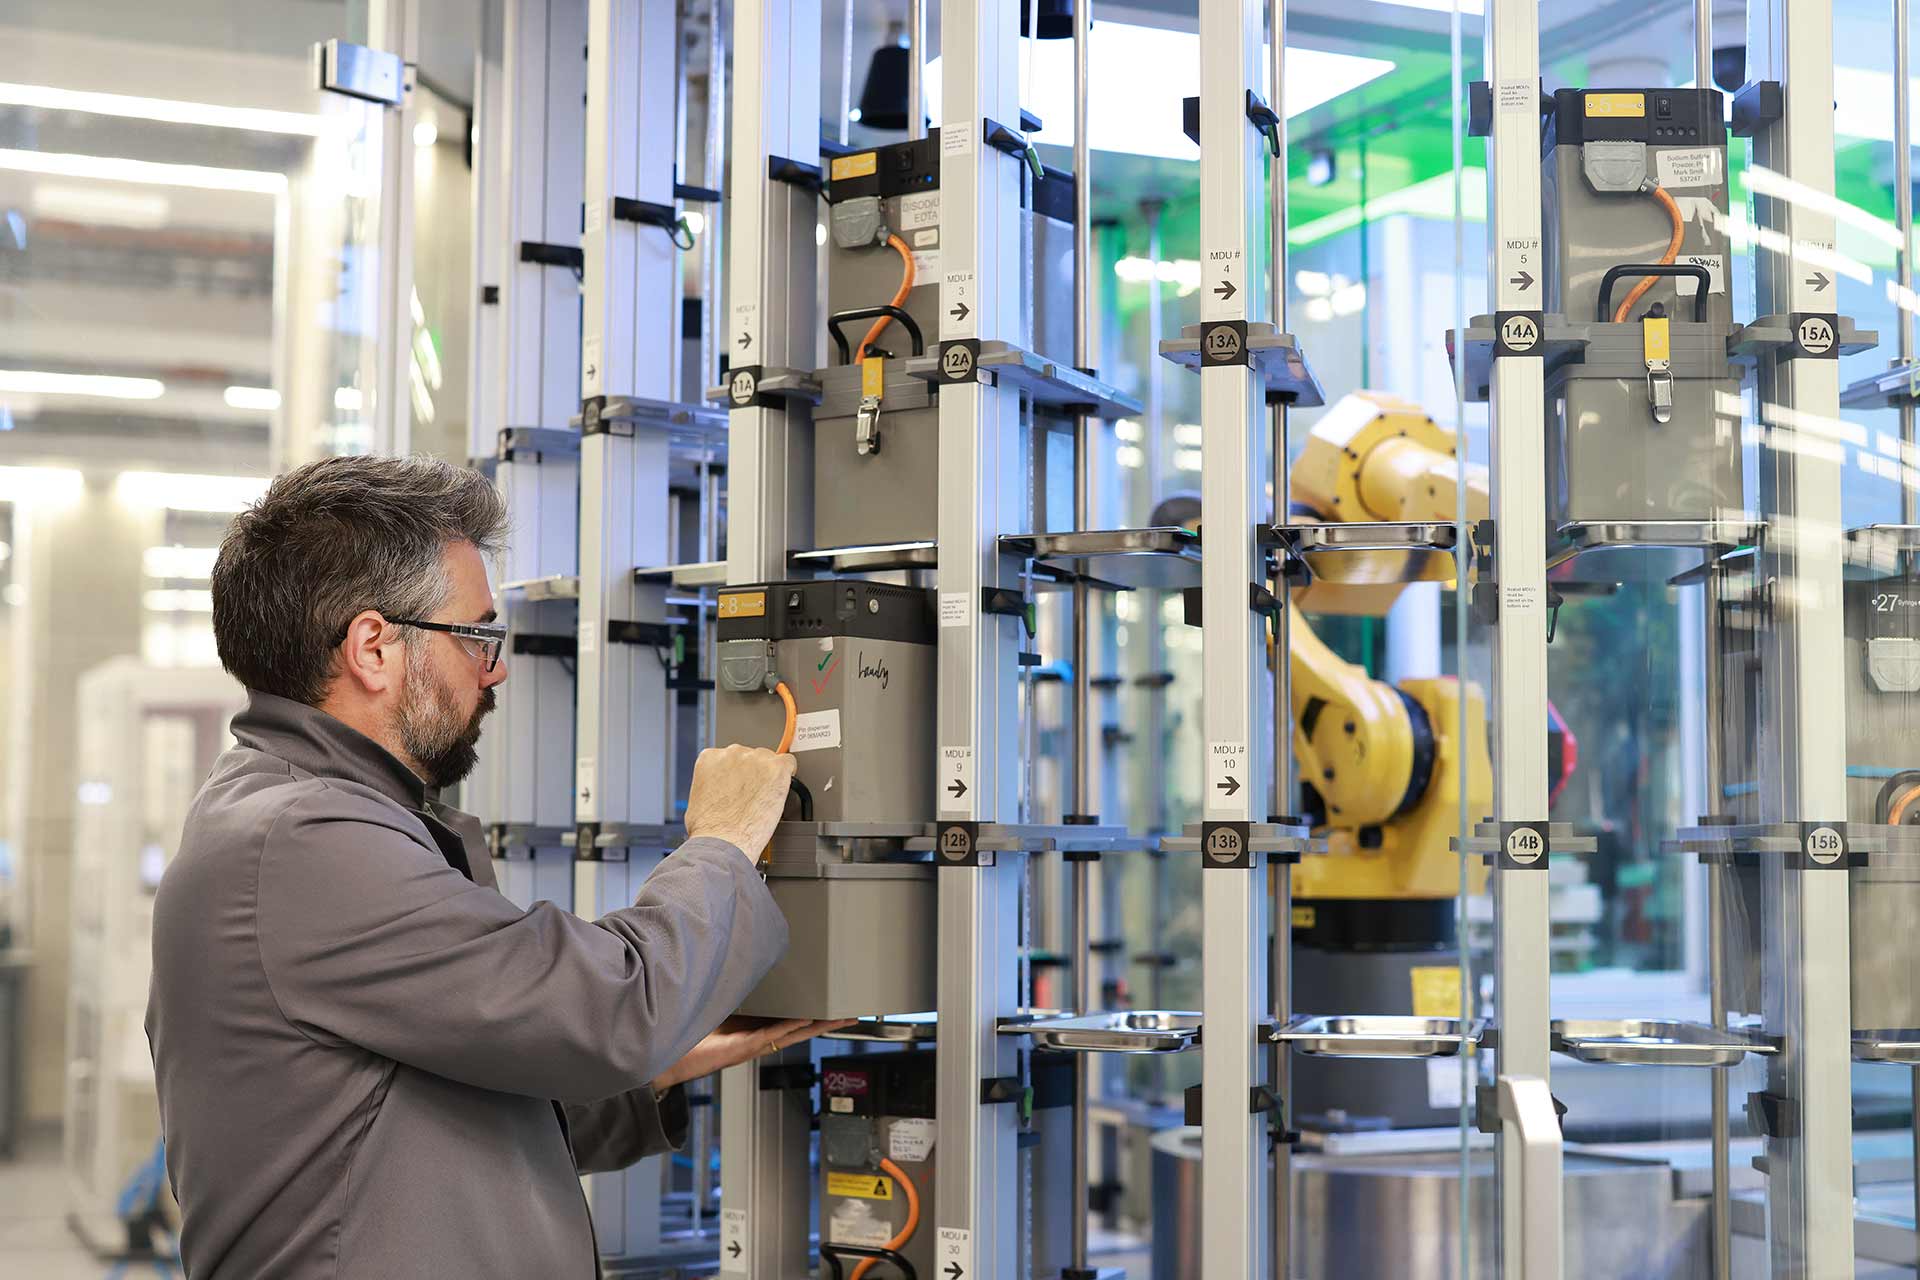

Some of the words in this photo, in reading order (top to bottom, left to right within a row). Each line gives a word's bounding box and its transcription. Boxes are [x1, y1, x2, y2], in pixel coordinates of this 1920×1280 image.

[1599, 97, 1611, 113] 5
[902, 198, 940, 213] DISODIU
[1506, 240, 1530, 250] MDU
[1532, 241, 1538, 249] #
[1210, 251, 1233, 260] MDU
[1235, 251, 1241, 259] #
[1520, 254, 1528, 264] 5
[1223, 264, 1230, 273] 4
[947, 274, 967, 283] MDU
[958, 286, 965, 296] 3
[1505, 324, 1535, 339] 14A
[1801, 326, 1832, 341] 15A
[1208, 334, 1238, 349] 13A
[945, 353, 970, 367] 12A
[732, 380, 753, 394] 11A
[729, 597, 738, 614] 8
[1877, 593, 1899, 612] 27
[945, 749, 965, 758] MDU
[1213, 745, 1236, 754] MDU
[1238, 745, 1245, 753] #
[956, 762, 962, 773] 9
[1223, 758, 1236, 768] 10
[943, 833, 967, 847] 12B
[1211, 835, 1238, 849] 13B
[1510, 835, 1539, 849] 14B
[1810, 835, 1838, 849] 15B
[828, 1073, 847, 1091] 29
[940, 1230, 961, 1240] MDU
[948, 1244, 960, 1255] 30
